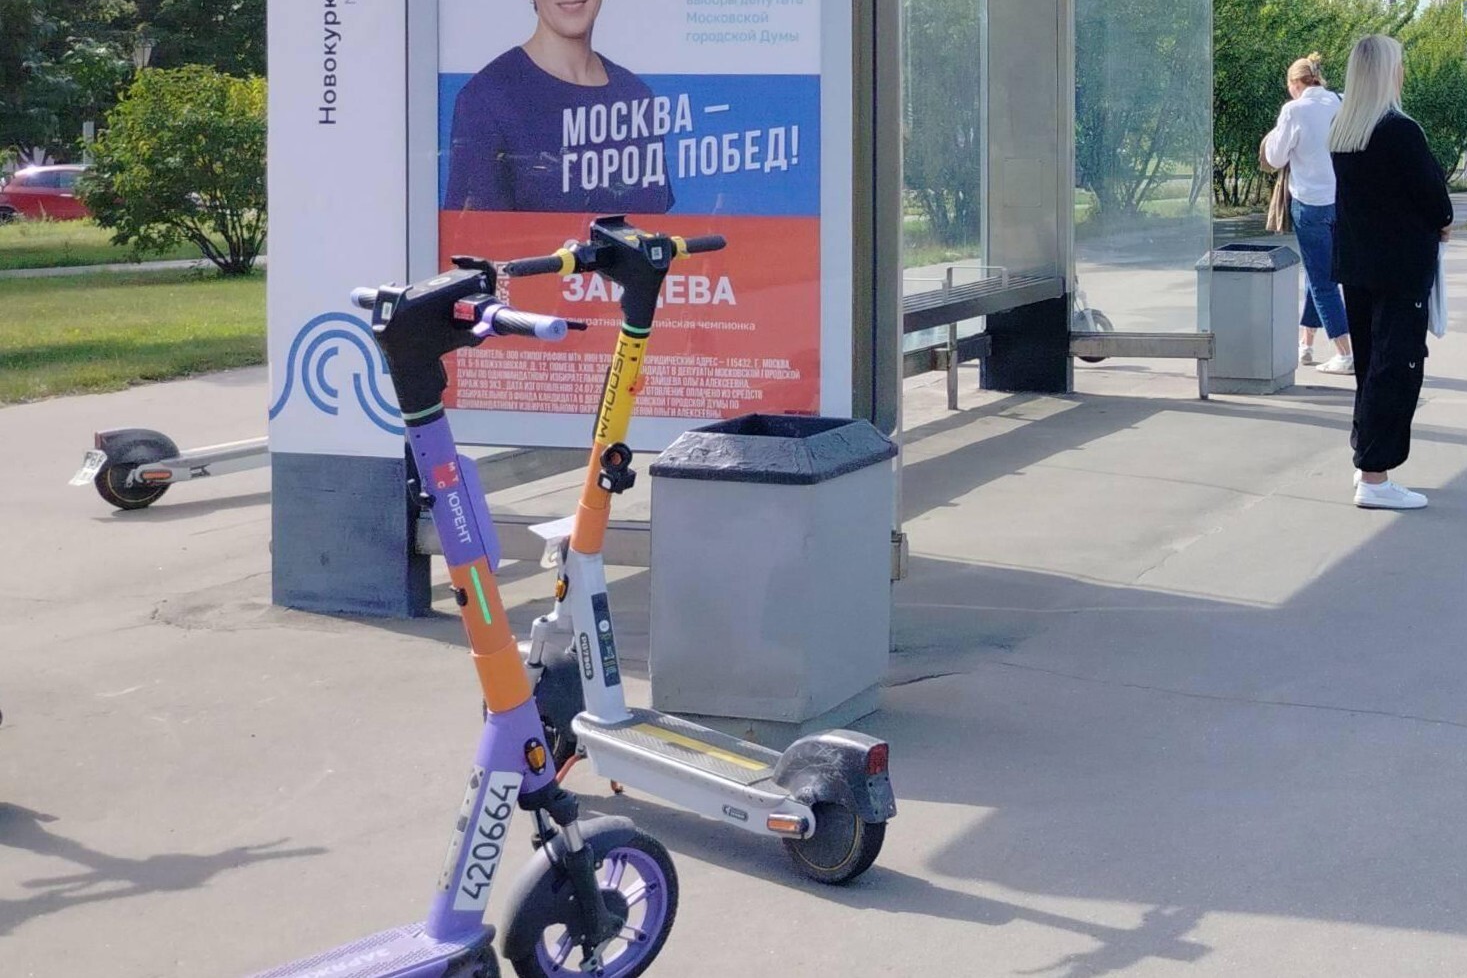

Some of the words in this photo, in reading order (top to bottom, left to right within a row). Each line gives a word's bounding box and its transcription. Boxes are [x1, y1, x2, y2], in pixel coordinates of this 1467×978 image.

[686, 9, 769, 25] Московской
[686, 28, 757, 45] городской
[759, 29, 801, 45] Думы
[562, 93, 693, 148] МОСКВА
[562, 141, 667, 193] ГОРОД
[678, 125, 800, 179] ПОБЕД!
[562, 271, 737, 309] ЗАЕВА
[697, 321, 757, 332] чемпионка
[597, 340, 629, 438] WHOOSH
[446, 491, 472, 543] ЮРЕНТ
[461, 784, 518, 900] 420664
